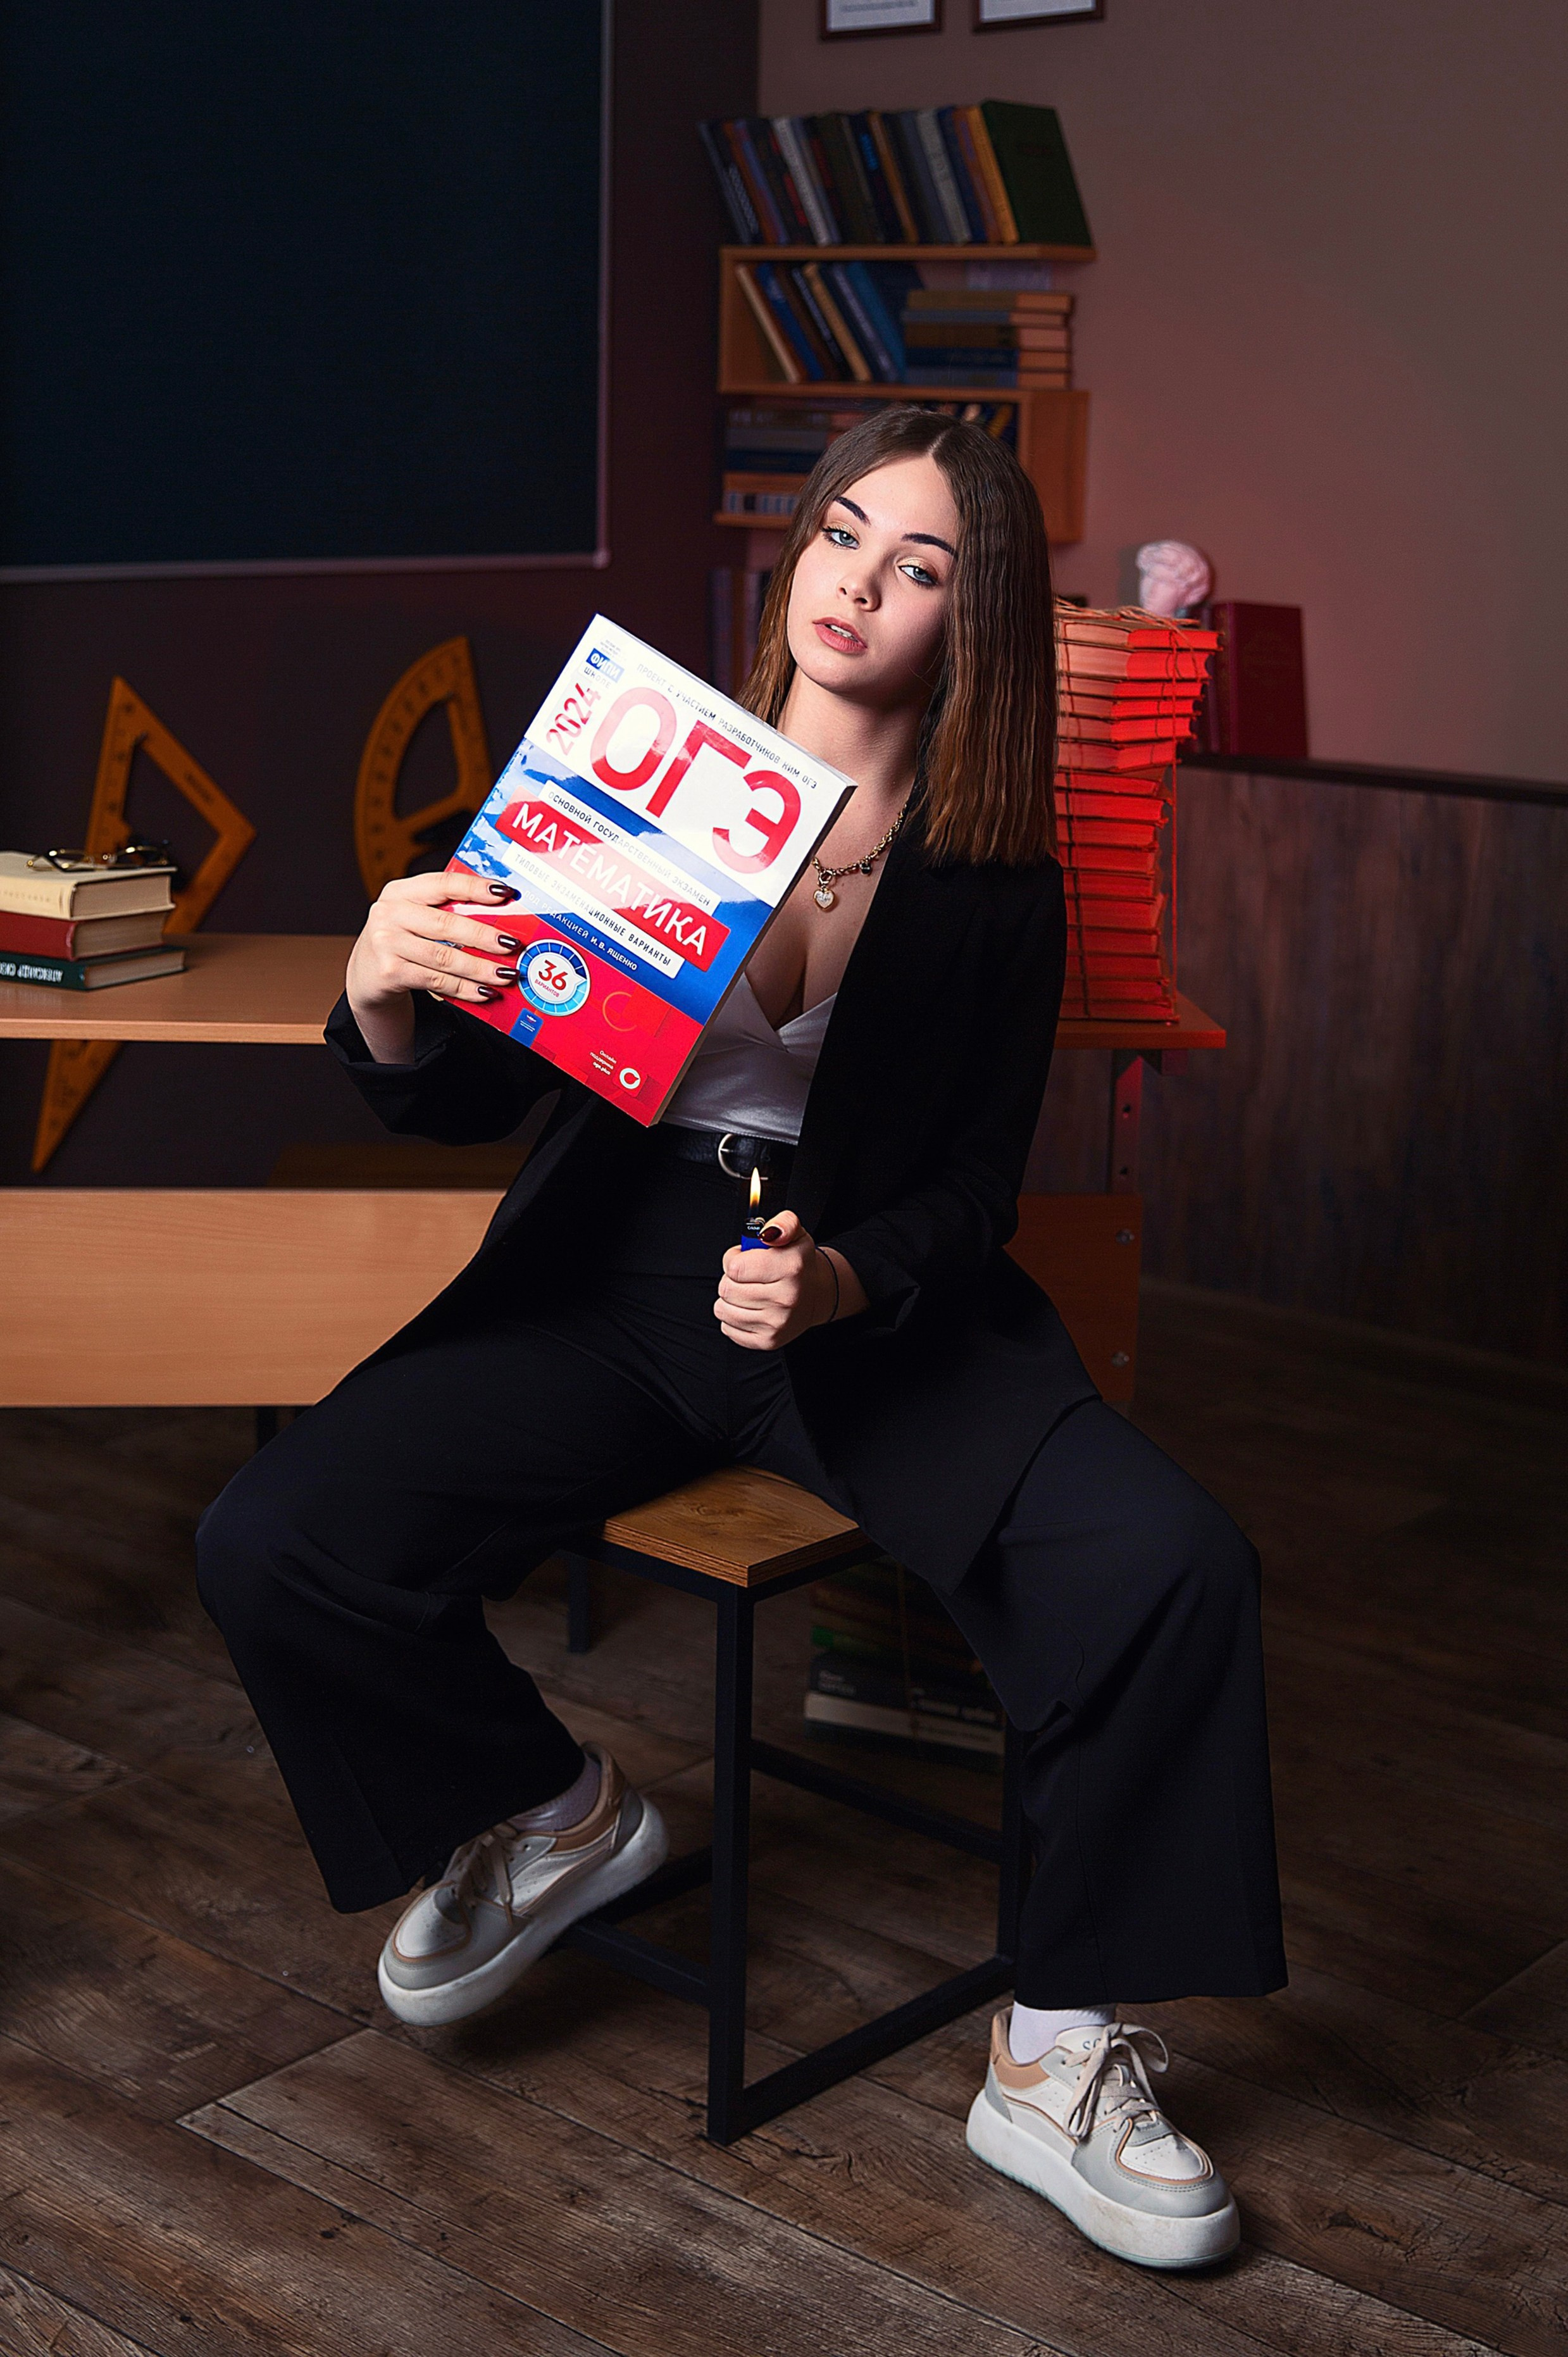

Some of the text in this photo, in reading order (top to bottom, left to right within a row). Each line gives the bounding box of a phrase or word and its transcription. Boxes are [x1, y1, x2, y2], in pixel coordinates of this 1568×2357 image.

[583, 666, 612, 689] ШКОЛЕ
[590, 653, 622, 679] ФИПИ
[545, 682, 602, 756] 2024
[635, 663, 666, 687] ПРОЕКТ
[675, 689, 716, 721] УЧАСТИЕМ
[716, 718, 780, 764] РАЗРАБОТЧИКОВ
[781, 761, 801, 778] КИМ
[801, 775, 817, 789] ОГЭ
[590, 687, 802, 874] ОГЭ
[512, 803, 707, 956] МАТЕМАТИКА
[547, 791, 711, 906] ОСНОВНОЙ ГОСУДАРСТВЕННЫЙ ЭКЗАМЕН
[513, 854, 672, 966] ТИПОВЫЕ ЭКЗАМЕНАЦИОННЫЕ ВАРИАНТЫ
[522, 889, 540, 906] ПОД
[540, 902, 590, 939] РЕДАКЦИЕЙ
[607, 947, 637, 970] ЯЩЕНКО
[533, 978, 560, 997] ВАРИАНТОВ
[538, 960, 568, 990] 36
